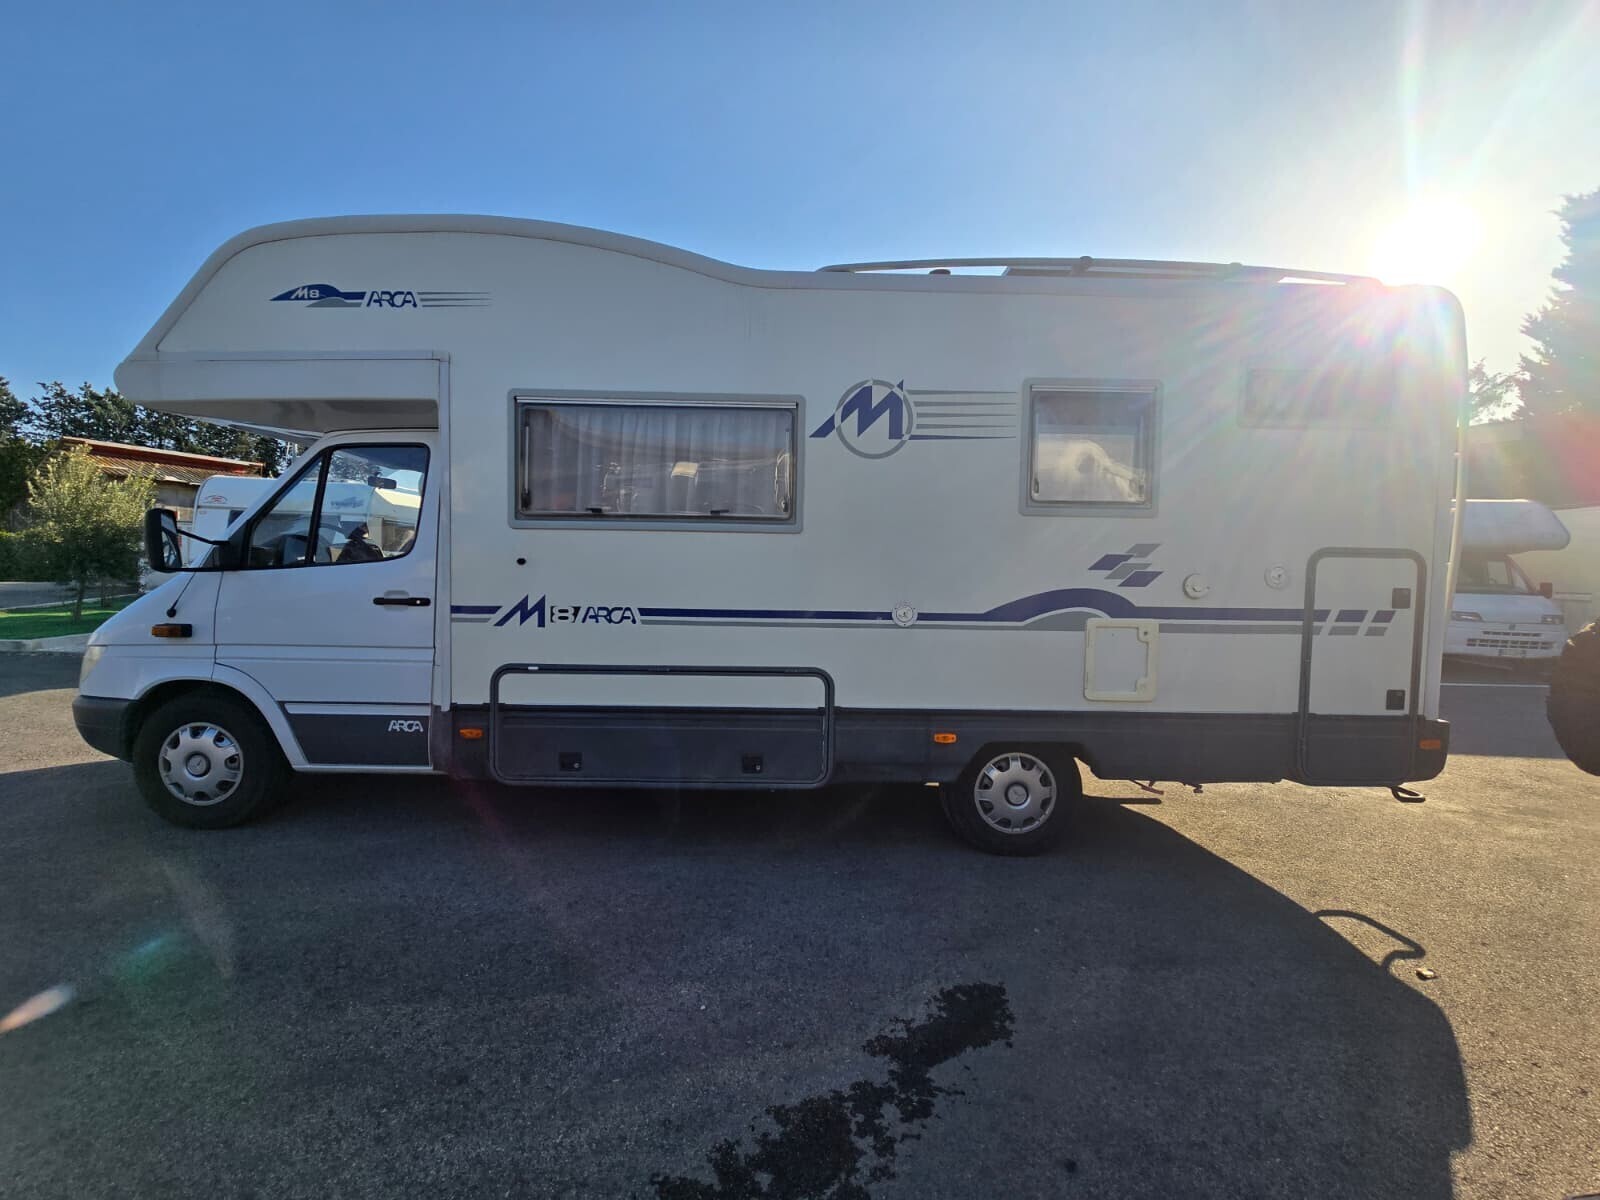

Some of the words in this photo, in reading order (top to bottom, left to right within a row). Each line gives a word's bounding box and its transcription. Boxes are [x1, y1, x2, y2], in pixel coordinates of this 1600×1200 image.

[366, 291, 418, 308] ARCA
[581, 606, 637, 625] ARCA
[388, 720, 424, 732] ARCA
